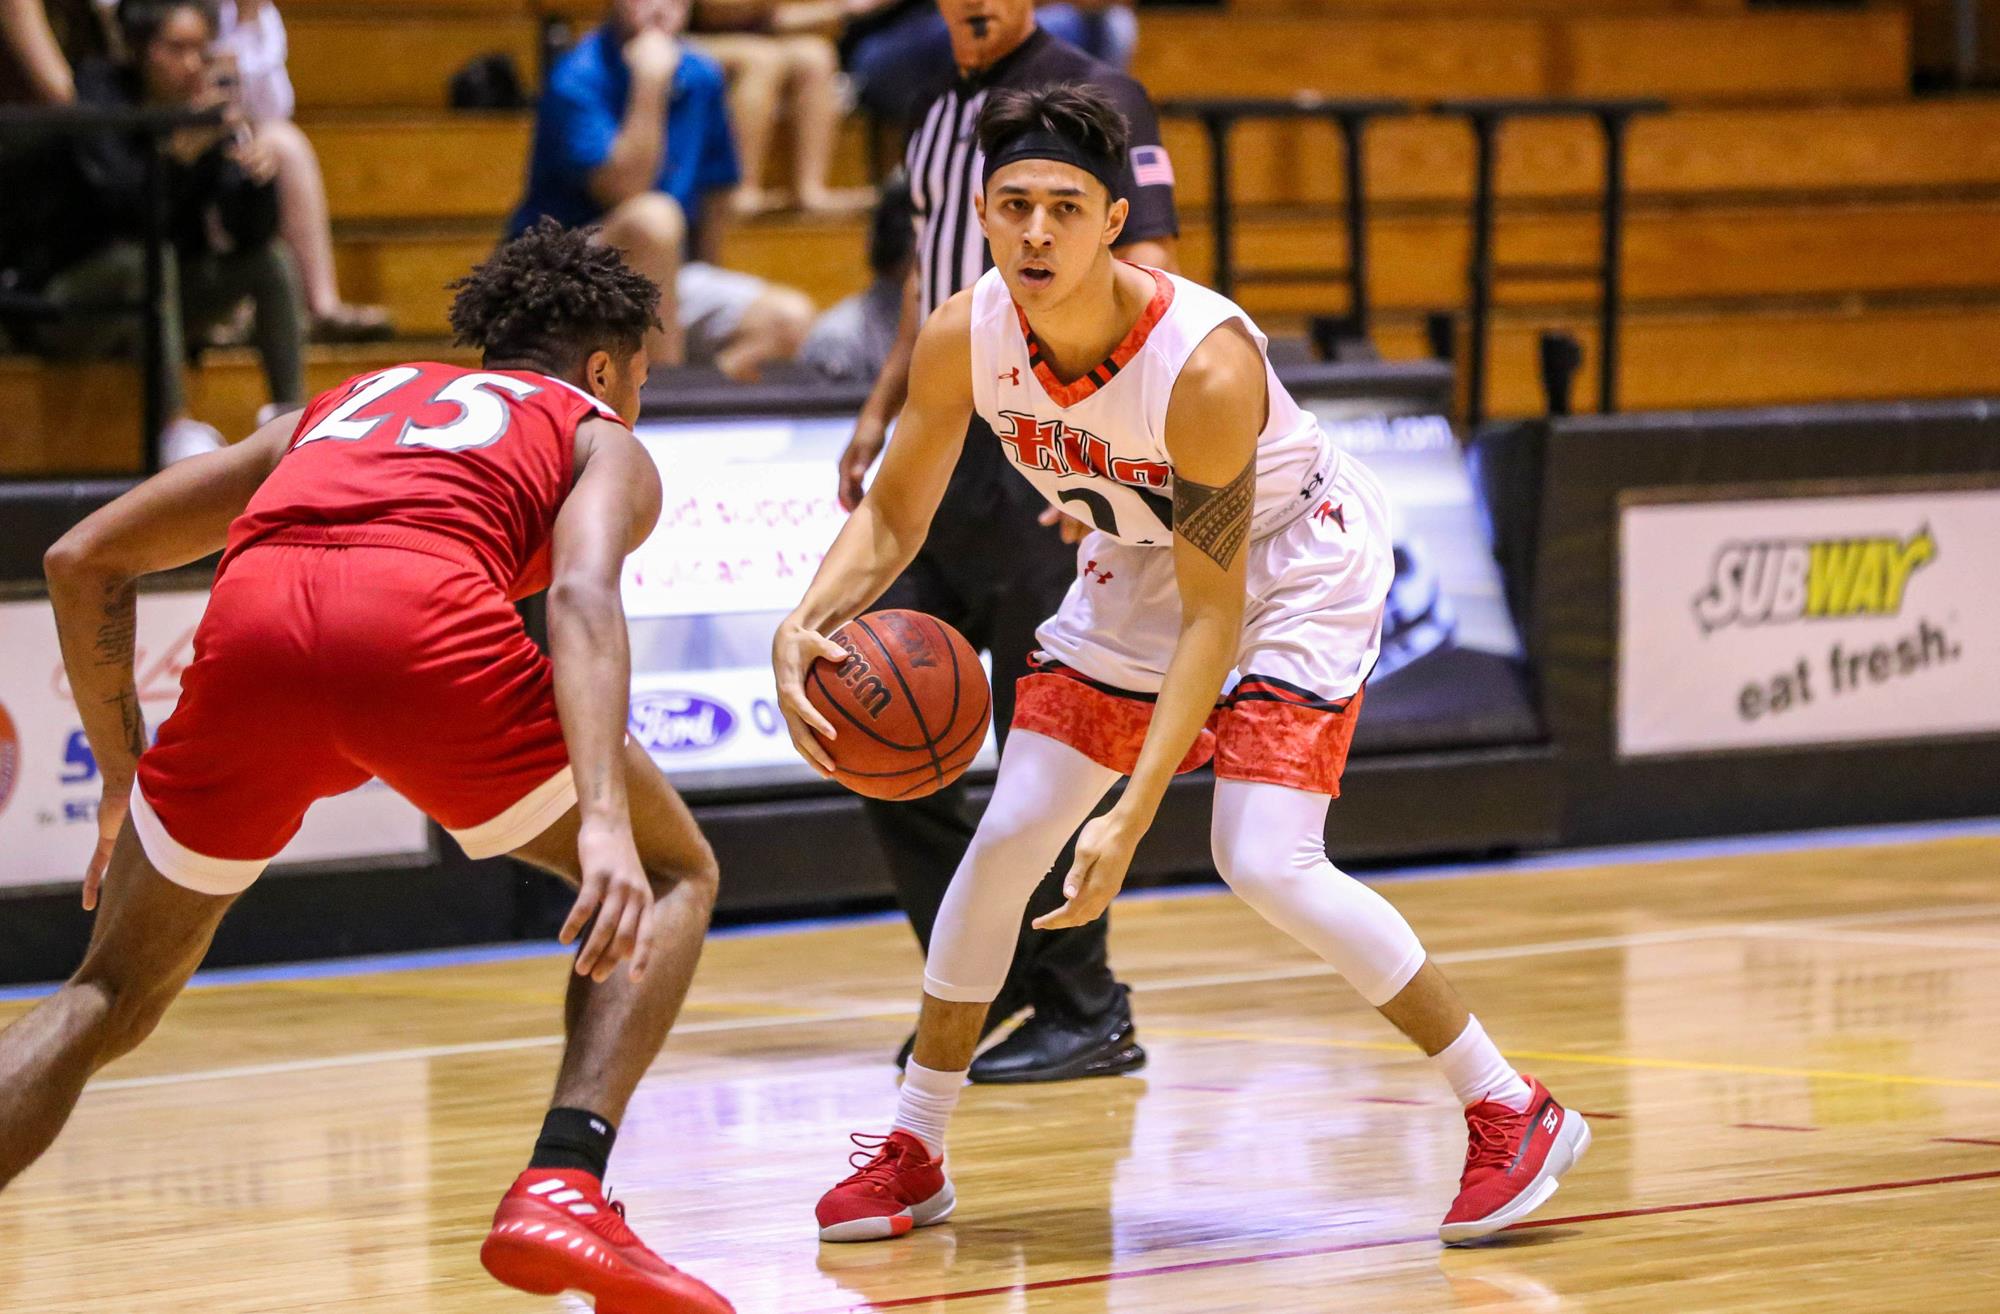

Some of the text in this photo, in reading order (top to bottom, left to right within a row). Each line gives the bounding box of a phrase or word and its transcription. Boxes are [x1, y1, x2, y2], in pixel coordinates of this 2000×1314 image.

[289, 366, 543, 453] 25
[1693, 522, 1937, 636] SUBWAY
[631, 698, 728, 749] Ford
[1737, 657, 1813, 721] eat
